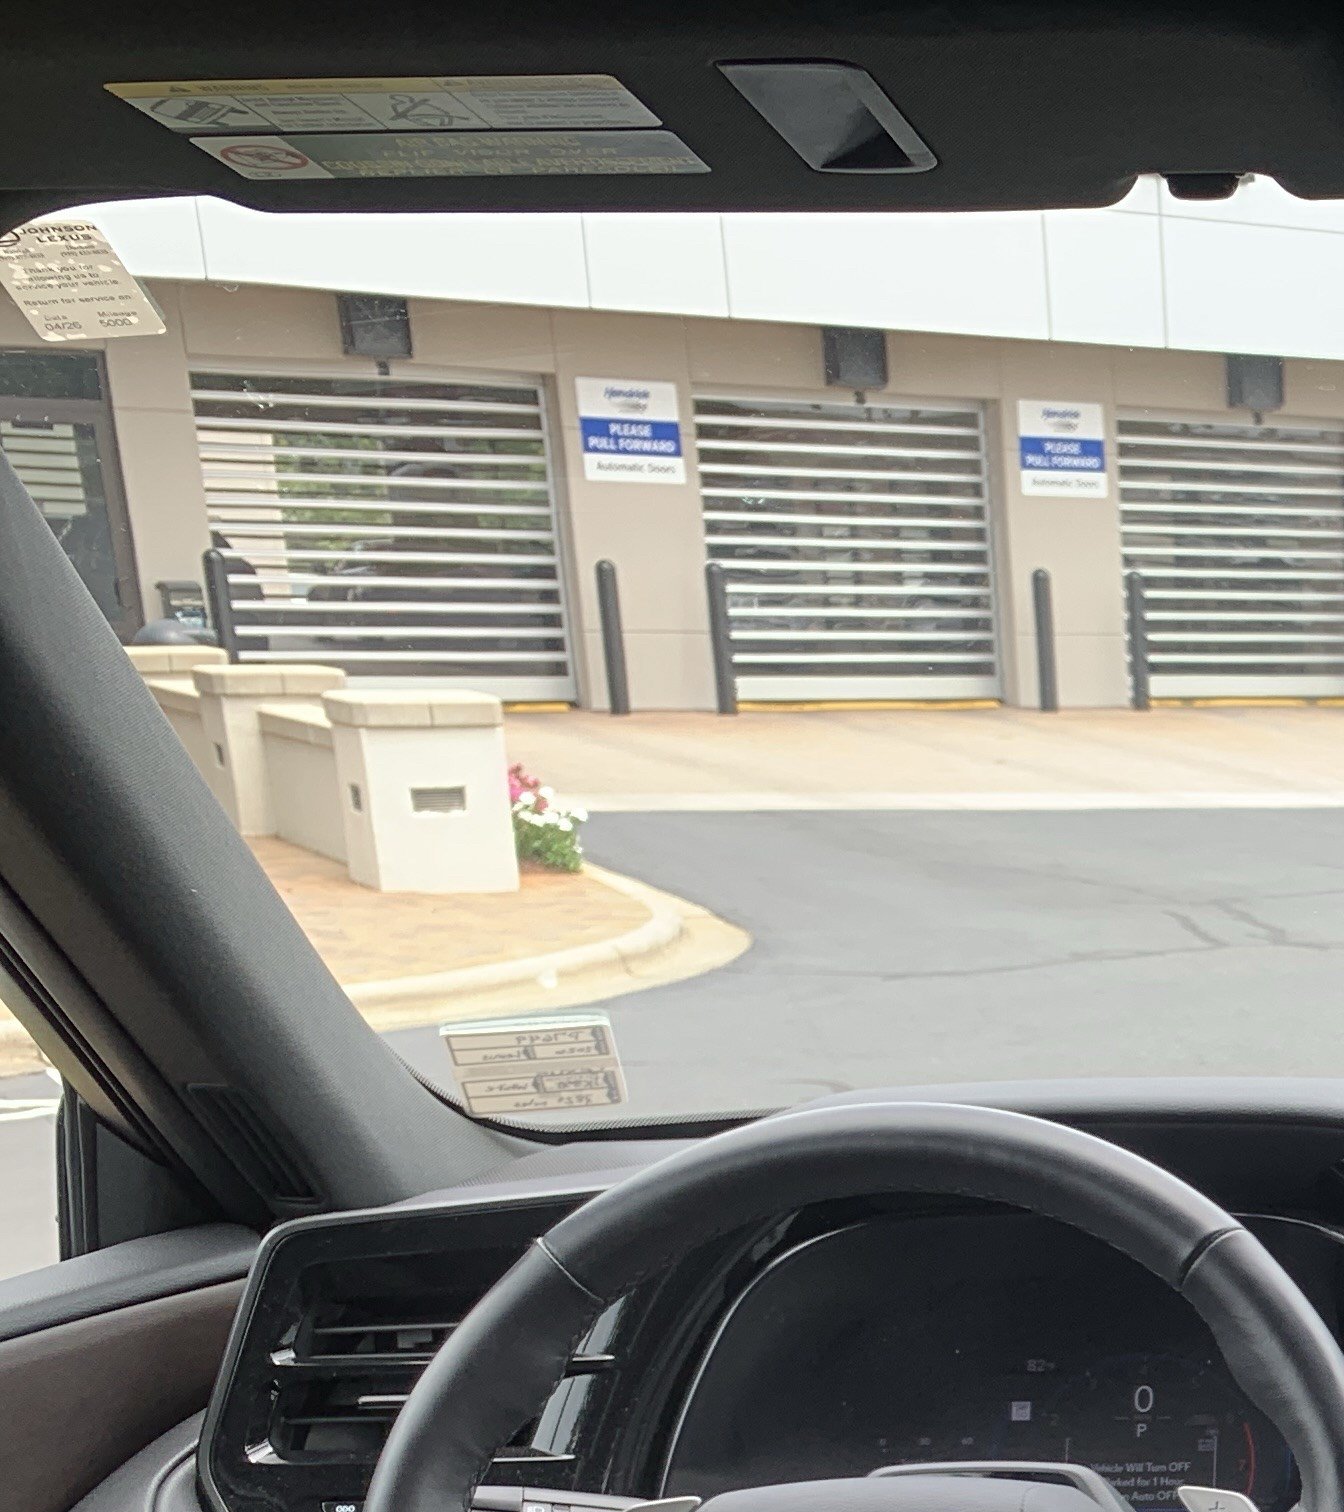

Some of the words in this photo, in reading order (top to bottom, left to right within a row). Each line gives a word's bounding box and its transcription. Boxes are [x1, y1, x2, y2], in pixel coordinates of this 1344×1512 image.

[19, 225, 98, 236] JOHNSON
[36, 233, 93, 243] LEXUS
[58, 266, 77, 274] you
[79, 263, 94, 271] for
[28, 274, 72, 283] allowing
[16, 283, 55, 292] service
[56, 281, 80, 290] your
[23, 299, 59, 307] Return
[62, 297, 76, 306] for
[78, 295, 116, 304] service
[97, 310, 138, 318] Mileage
[608, 422, 653, 437] PLEASE
[588, 435, 618, 450] PULL
[618, 437, 676, 453] FORWARD
[1043, 441, 1081, 455] PLEASE
[596, 461, 644, 473] Automatic
[647, 463, 676, 474] Doors
[1025, 454, 1050, 467] PULL
[1051, 455, 1101, 469] FORWARD
[1134, 1385, 1153, 1413] 0
[1136, 1423, 1147, 1438] P
[1125, 1462, 1144, 1473] Will
[1146, 1462, 1167, 1473] Turn
[1168, 1461, 1192, 1472] OFF
[1137, 1477, 1150, 1487] for
[335, 1504, 356, 1512] ODO
